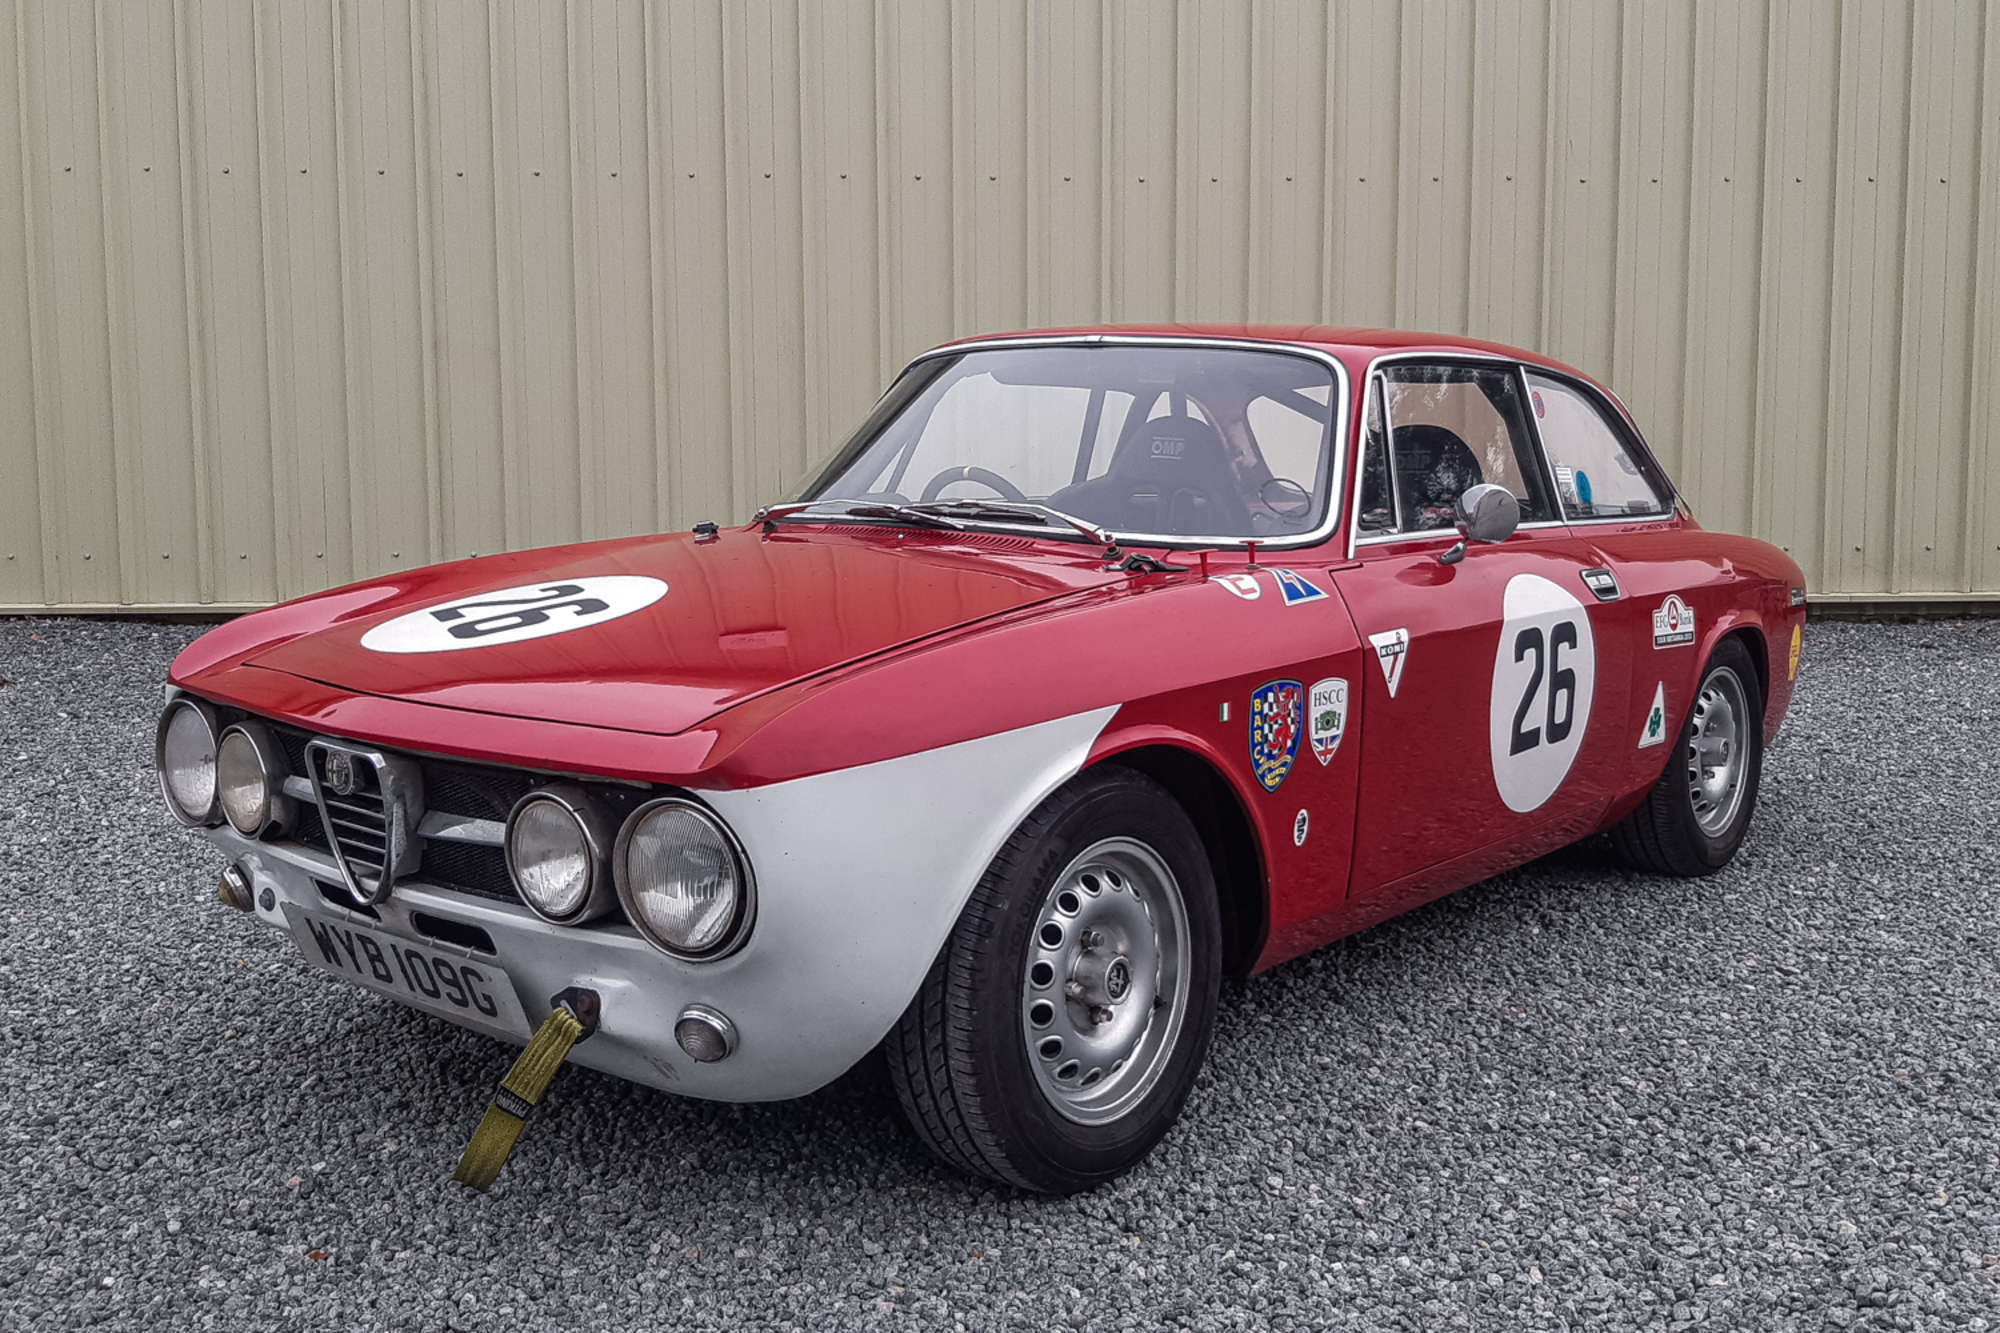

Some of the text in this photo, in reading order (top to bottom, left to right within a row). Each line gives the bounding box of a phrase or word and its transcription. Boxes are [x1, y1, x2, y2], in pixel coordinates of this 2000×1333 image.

[1151, 440, 1184, 456] OMP
[429, 585, 611, 639] 26
[1380, 644, 1404, 657] KONI
[1314, 688, 1344, 707] HSCC
[1509, 621, 1577, 757] 26
[1253, 698, 1262, 760] BARC
